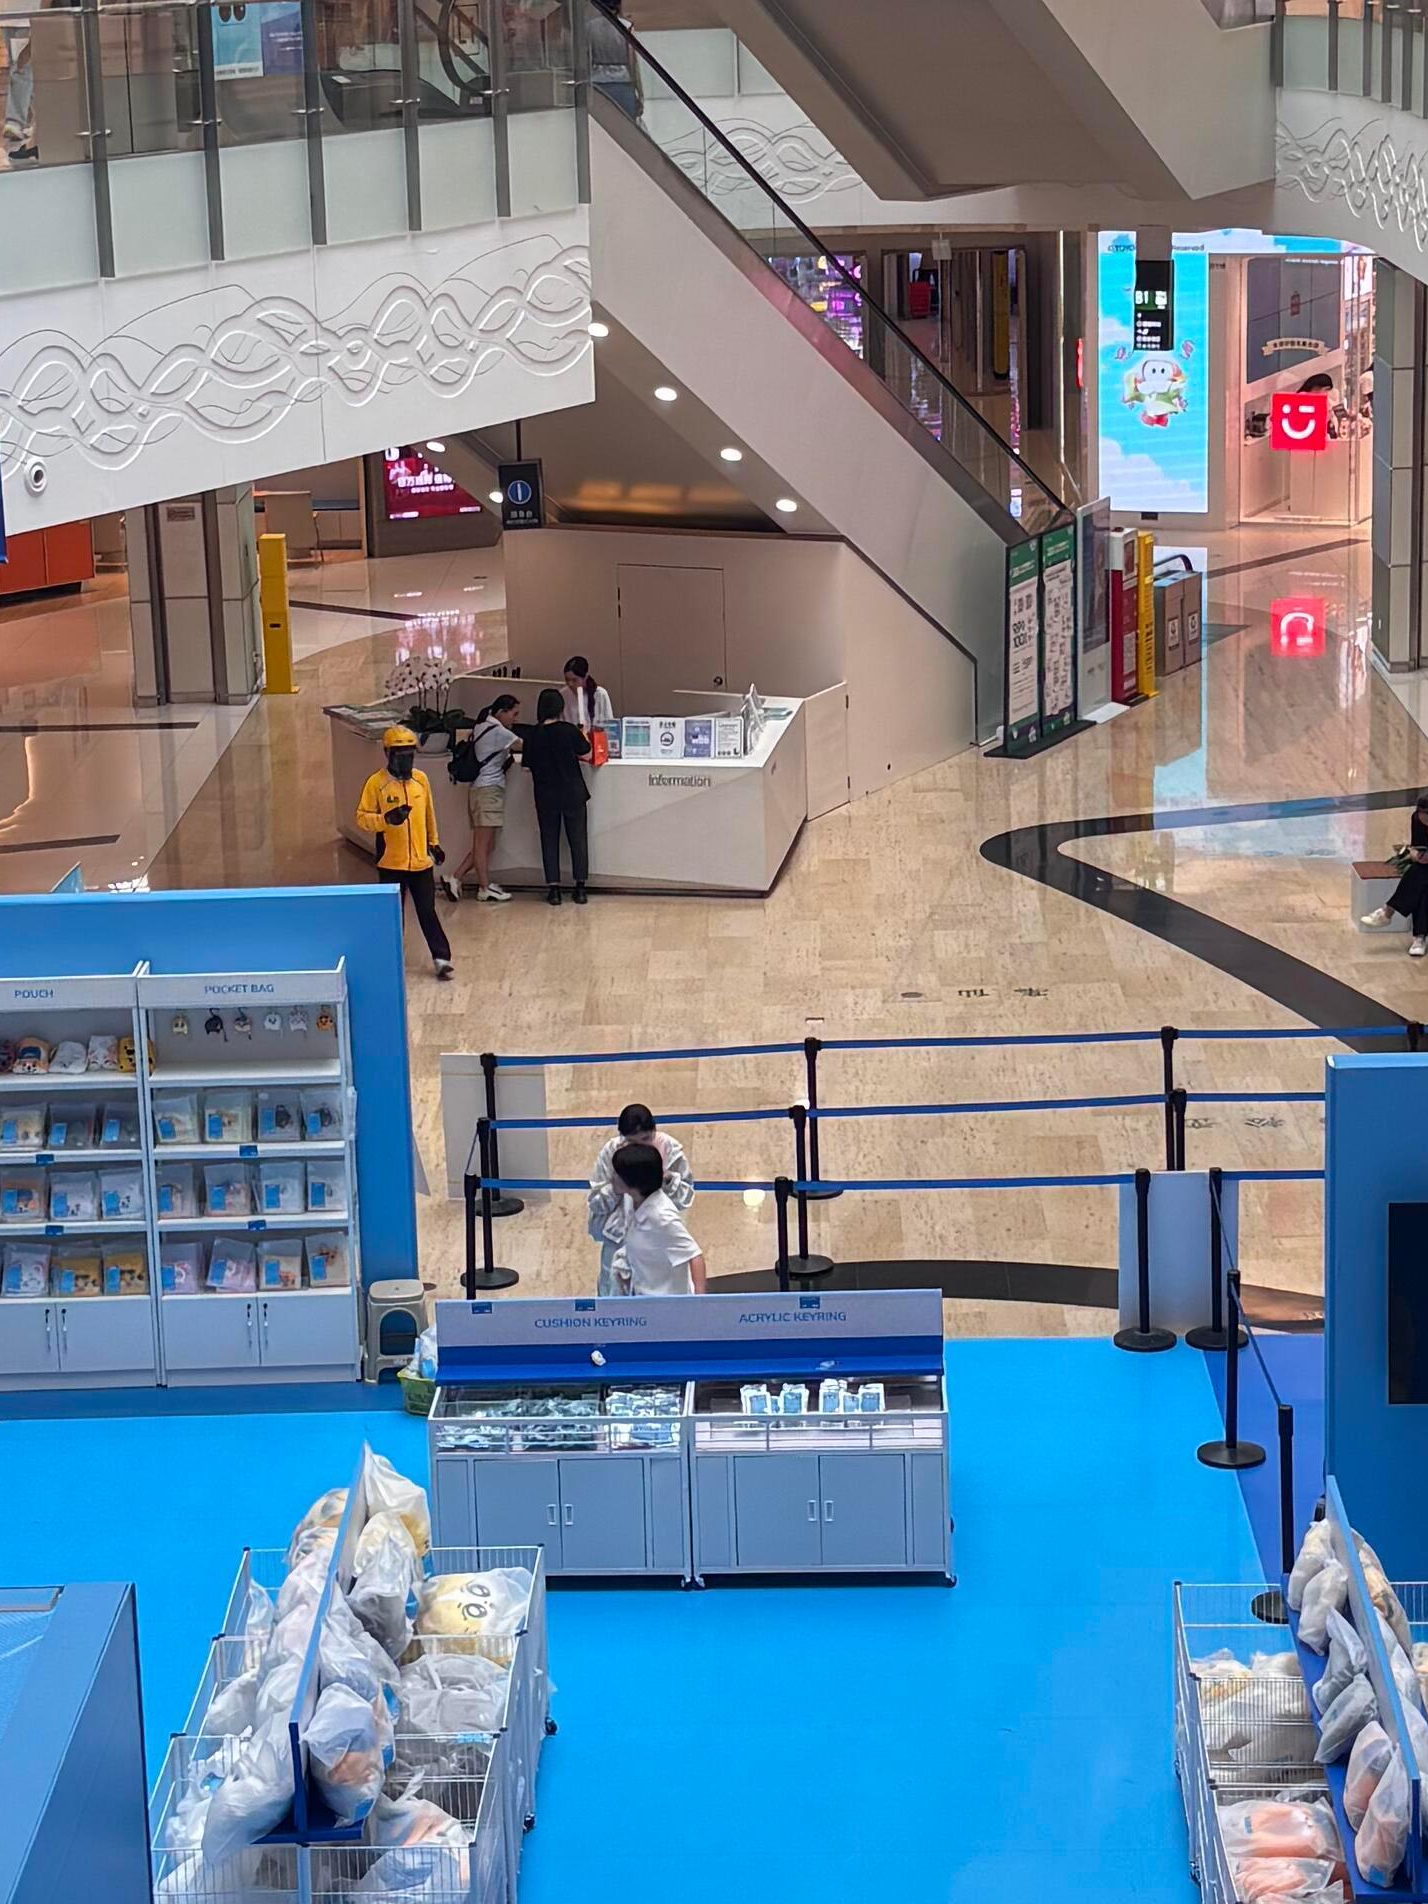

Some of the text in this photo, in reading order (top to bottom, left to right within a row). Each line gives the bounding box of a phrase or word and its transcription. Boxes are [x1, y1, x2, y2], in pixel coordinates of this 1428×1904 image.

[649, 774, 711, 787] Information
[15, 989, 54, 998] POUCH
[204, 984, 275, 995] POCKET BAG
[535, 1316, 647, 1329] CUSHION KEYRING
[739, 1311, 847, 1324] ACRYLIC KEYRING
